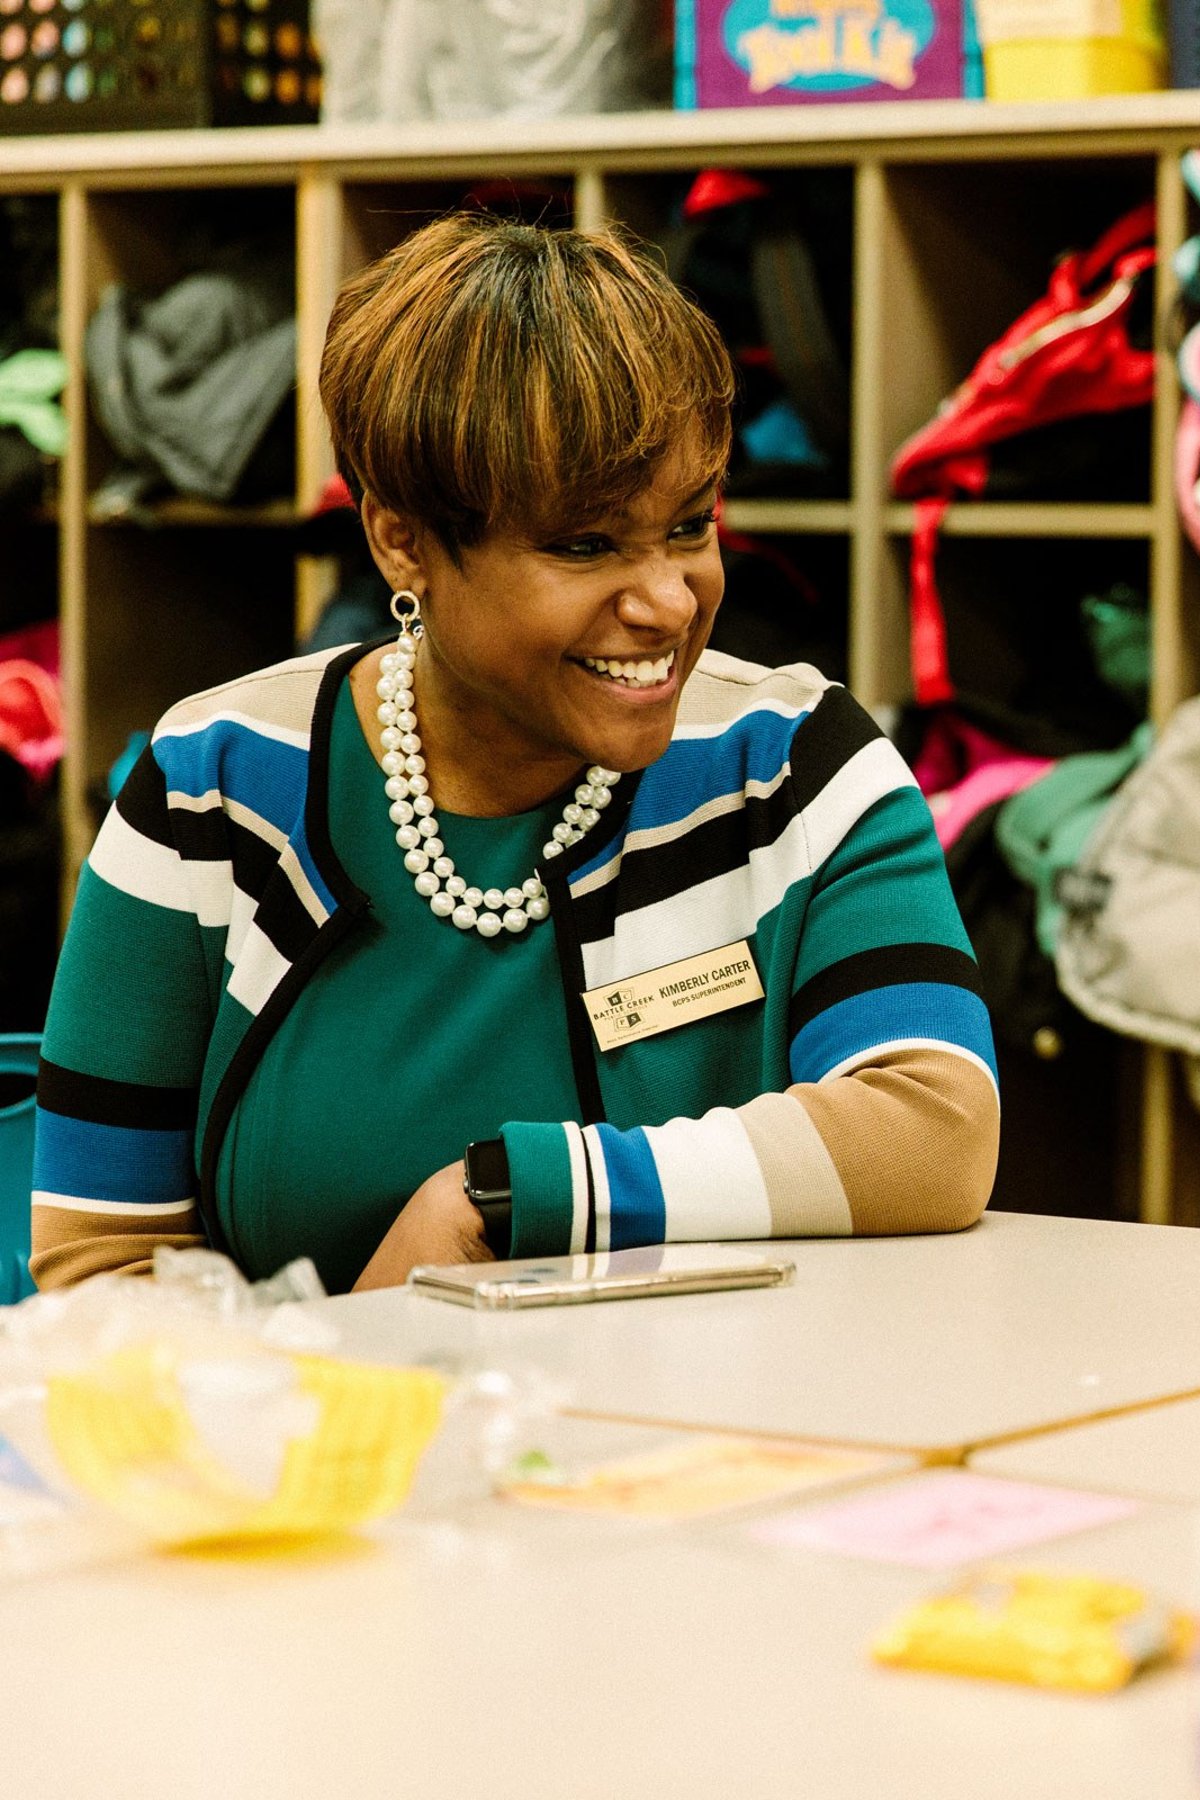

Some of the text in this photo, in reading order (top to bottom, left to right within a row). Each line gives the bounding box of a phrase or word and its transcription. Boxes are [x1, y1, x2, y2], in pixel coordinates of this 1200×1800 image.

[658, 960, 751, 999] KIMBERLY CARTER
[672, 977, 747, 1008] BCPS SUPERINTENDENT
[593, 1005, 625, 1021] BATTLE
[626, 994, 655, 1010] CREEK
